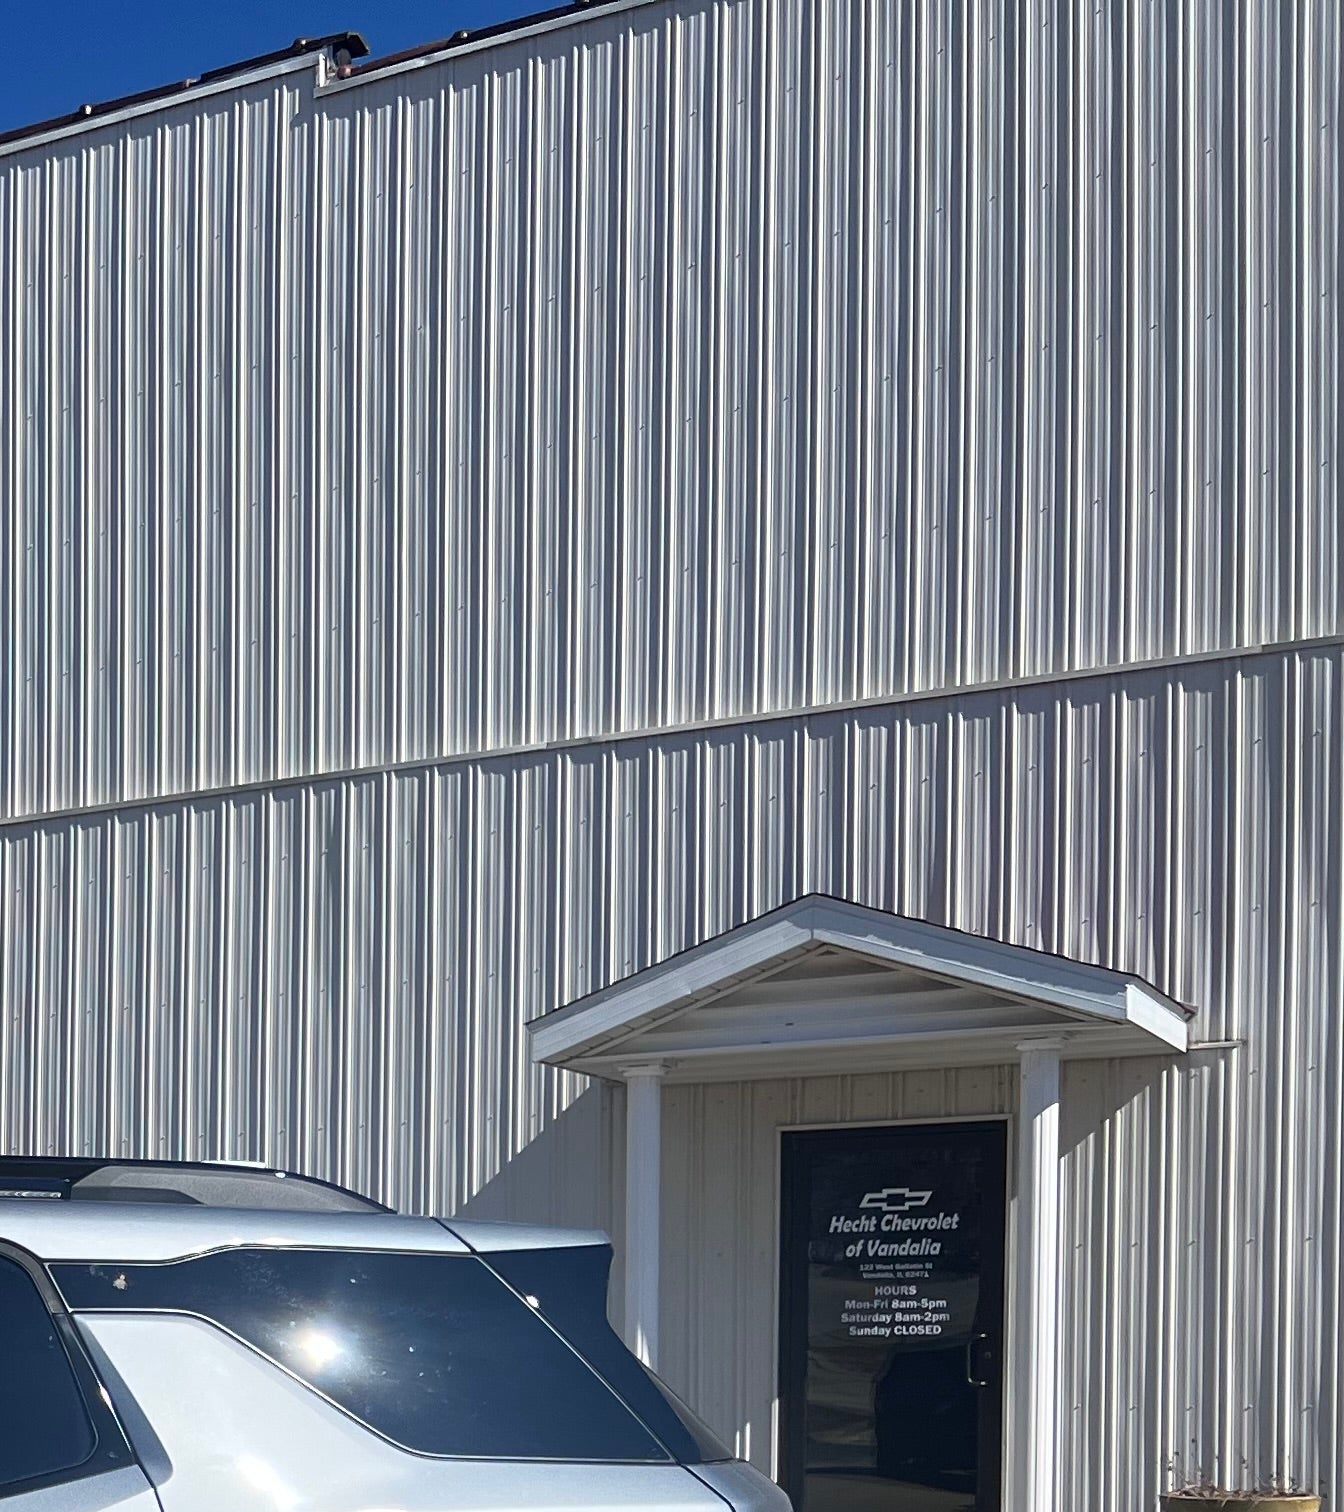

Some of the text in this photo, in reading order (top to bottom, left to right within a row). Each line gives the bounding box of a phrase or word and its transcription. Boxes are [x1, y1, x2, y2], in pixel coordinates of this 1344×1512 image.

[829, 1212, 960, 1233] Hecht Chevrolet
[845, 1238, 941, 1257] of Vandalia
[874, 1285, 917, 1296] HOURS
[844, 1298, 947, 1310] Mon-Fri 8am-5pm
[841, 1311, 951, 1324] Saturday 8am-2pm
[849, 1325, 942, 1337] Sunday CLOSED
